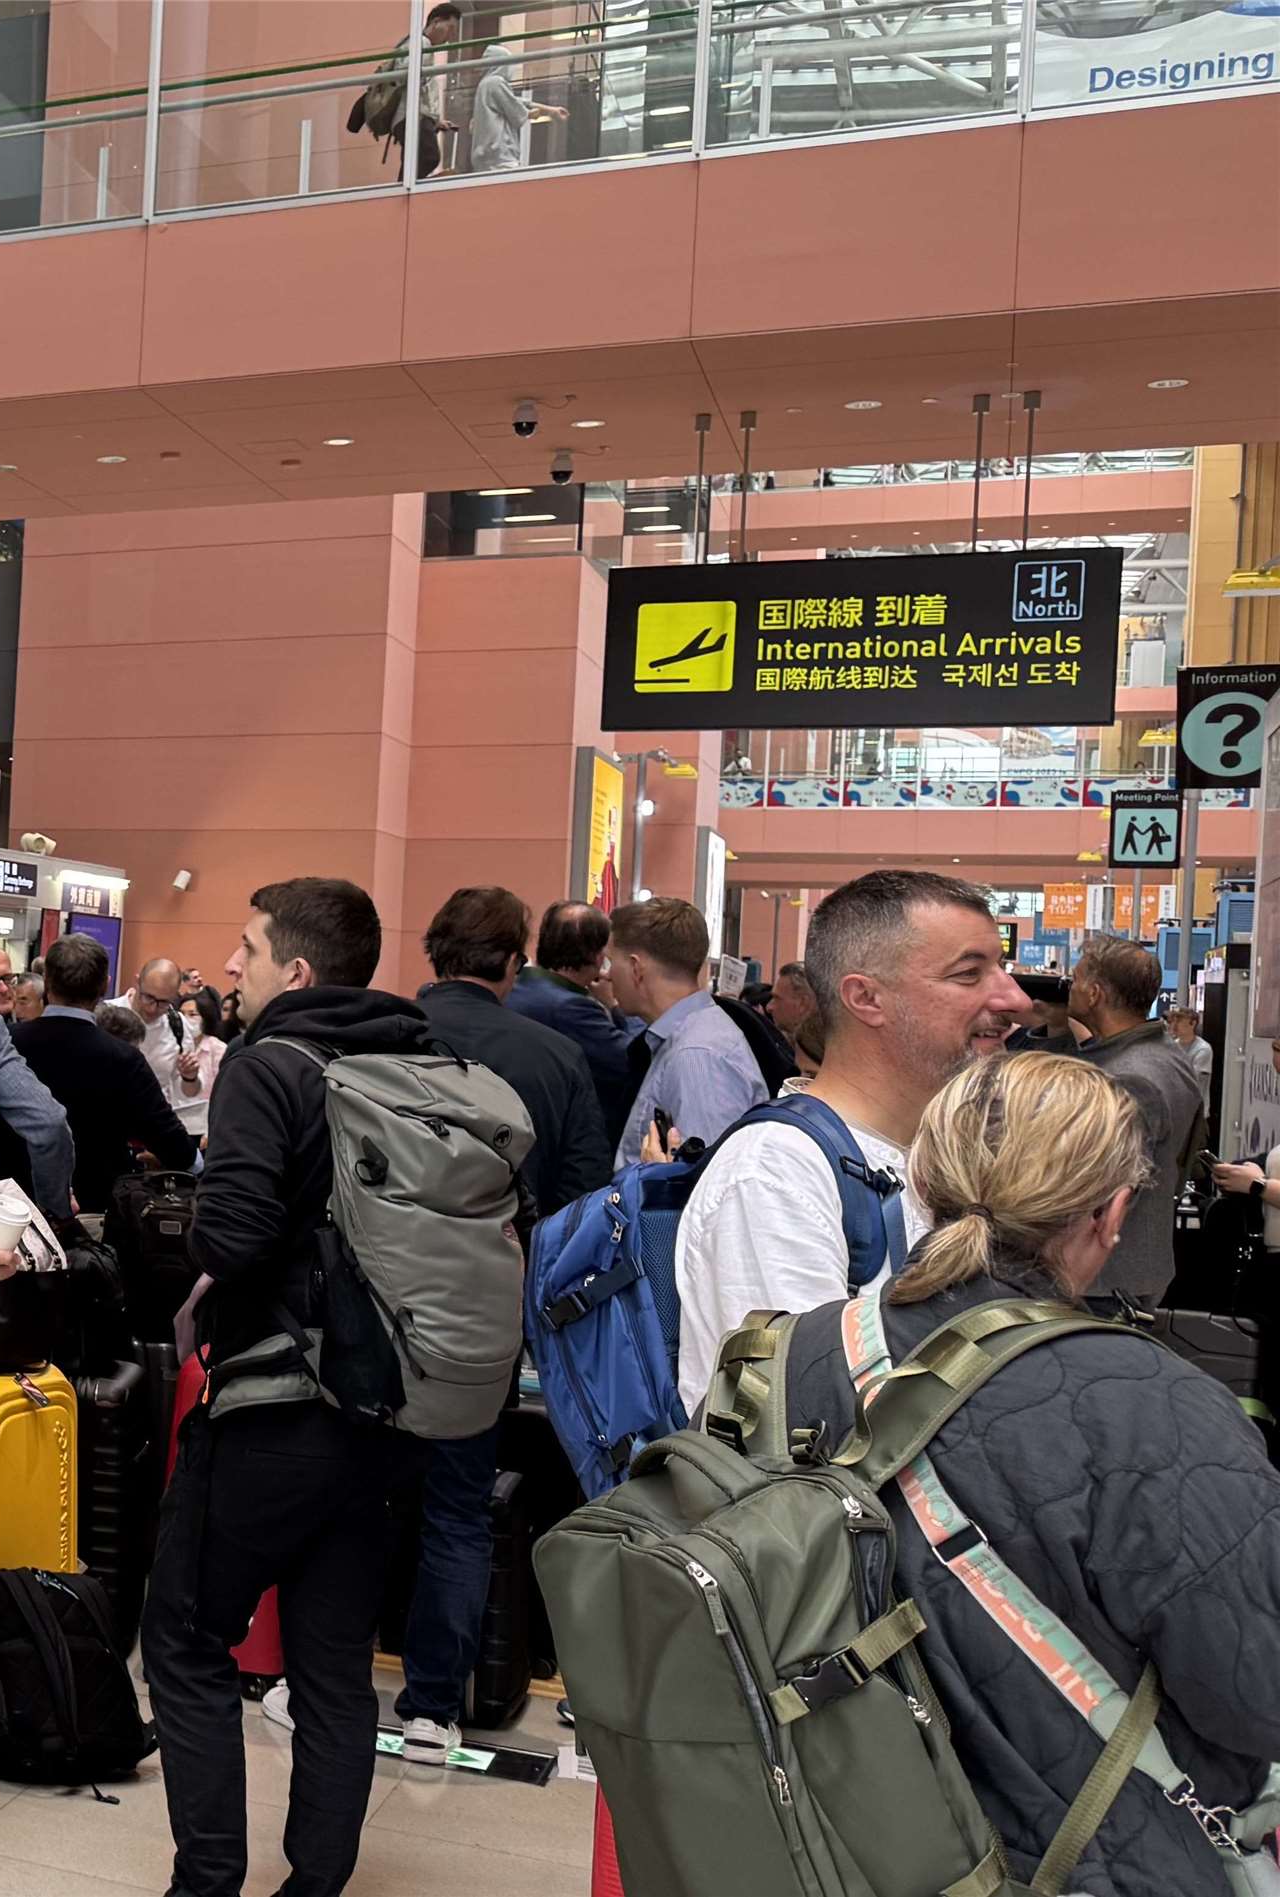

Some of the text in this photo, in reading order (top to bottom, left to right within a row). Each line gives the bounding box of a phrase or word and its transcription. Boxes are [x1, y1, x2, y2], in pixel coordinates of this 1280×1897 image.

[1088, 51, 1275, 94] Designing
[1030, 565, 1068, 598] 北
[758, 593, 948, 631] 国際線 到着
[1018, 599, 1079, 619] North
[756, 630, 1082, 662] International Arrivals
[943, 660, 1081, 688] 국제선 도착
[1191, 671, 1277, 685] Information
[1115, 792, 1179, 803] Meeting Point
